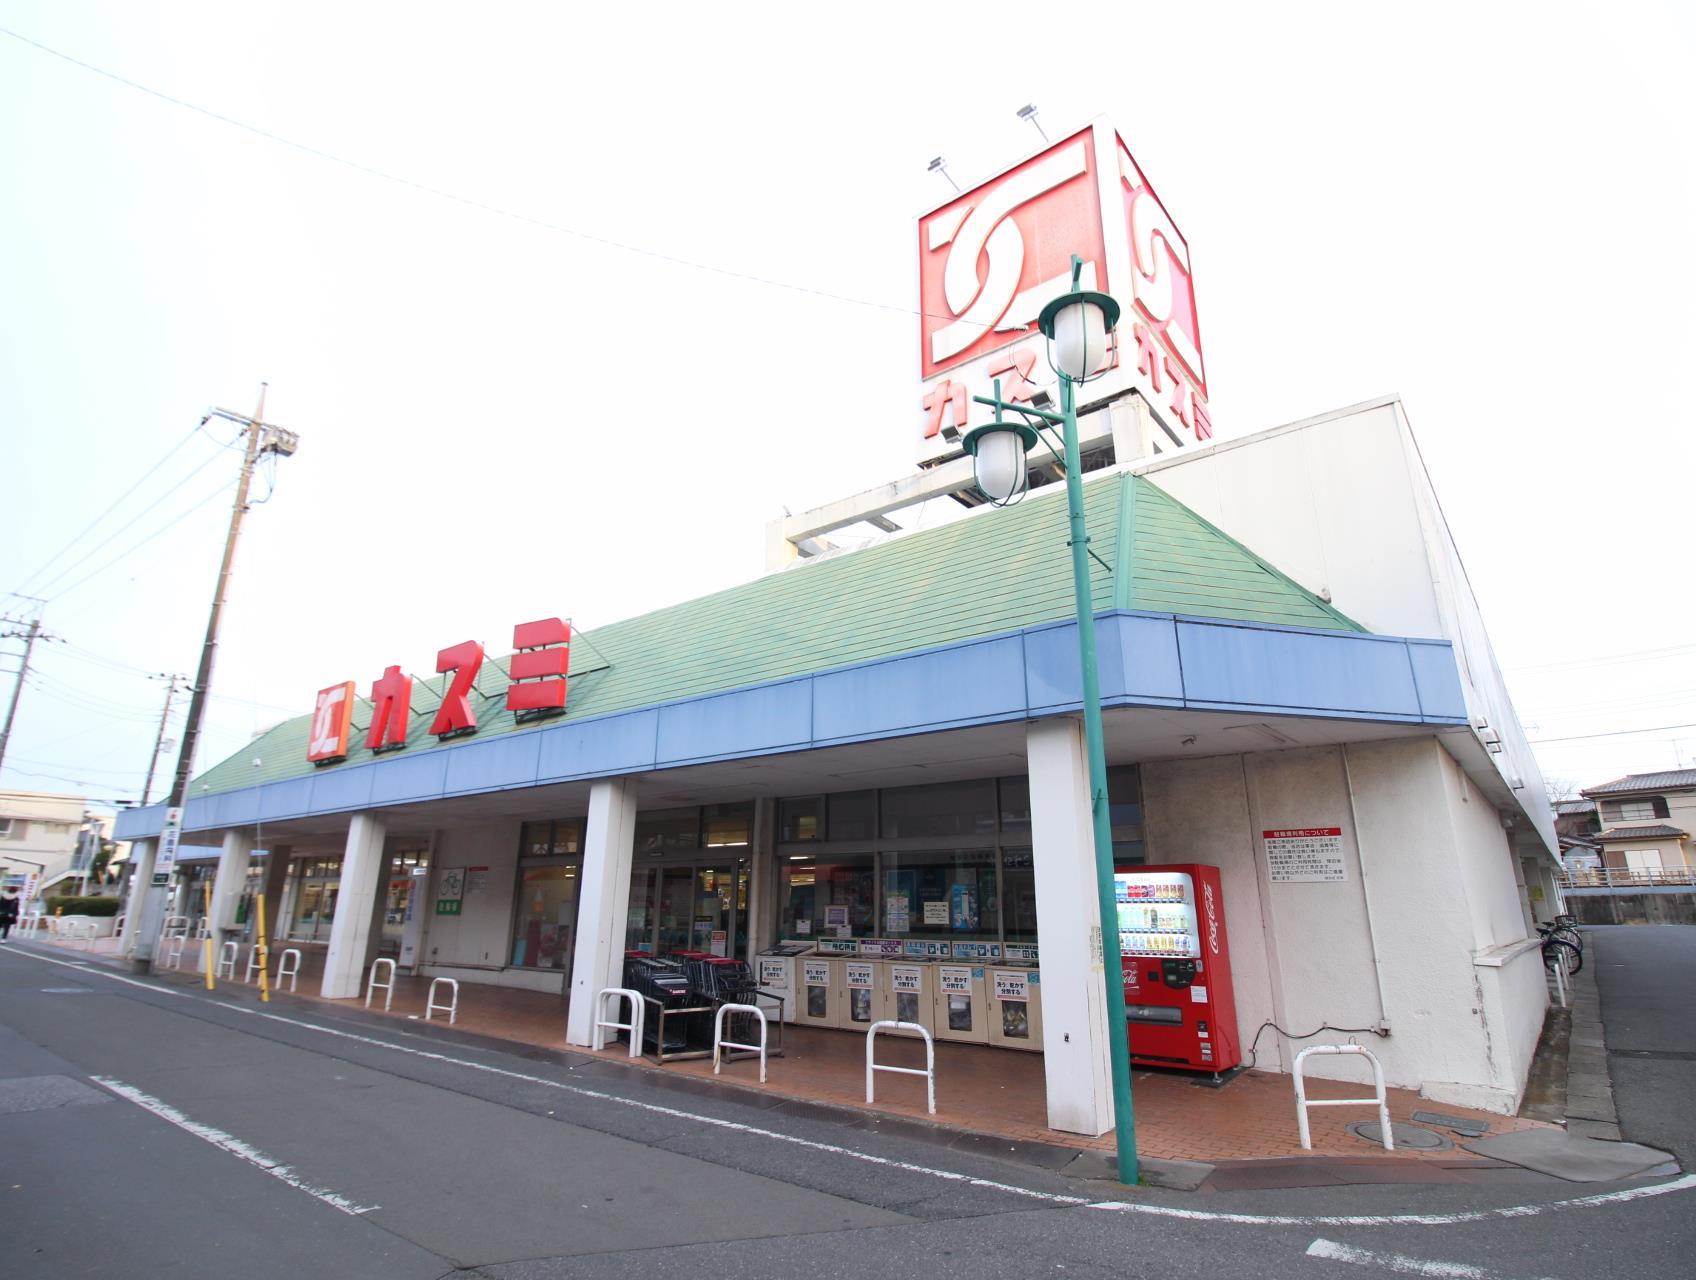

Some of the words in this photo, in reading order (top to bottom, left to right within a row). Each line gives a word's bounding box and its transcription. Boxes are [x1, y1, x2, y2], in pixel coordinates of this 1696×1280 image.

[364, 617, 571, 750] カスミ
[1203, 880, 1219, 955] Coca-Cola
